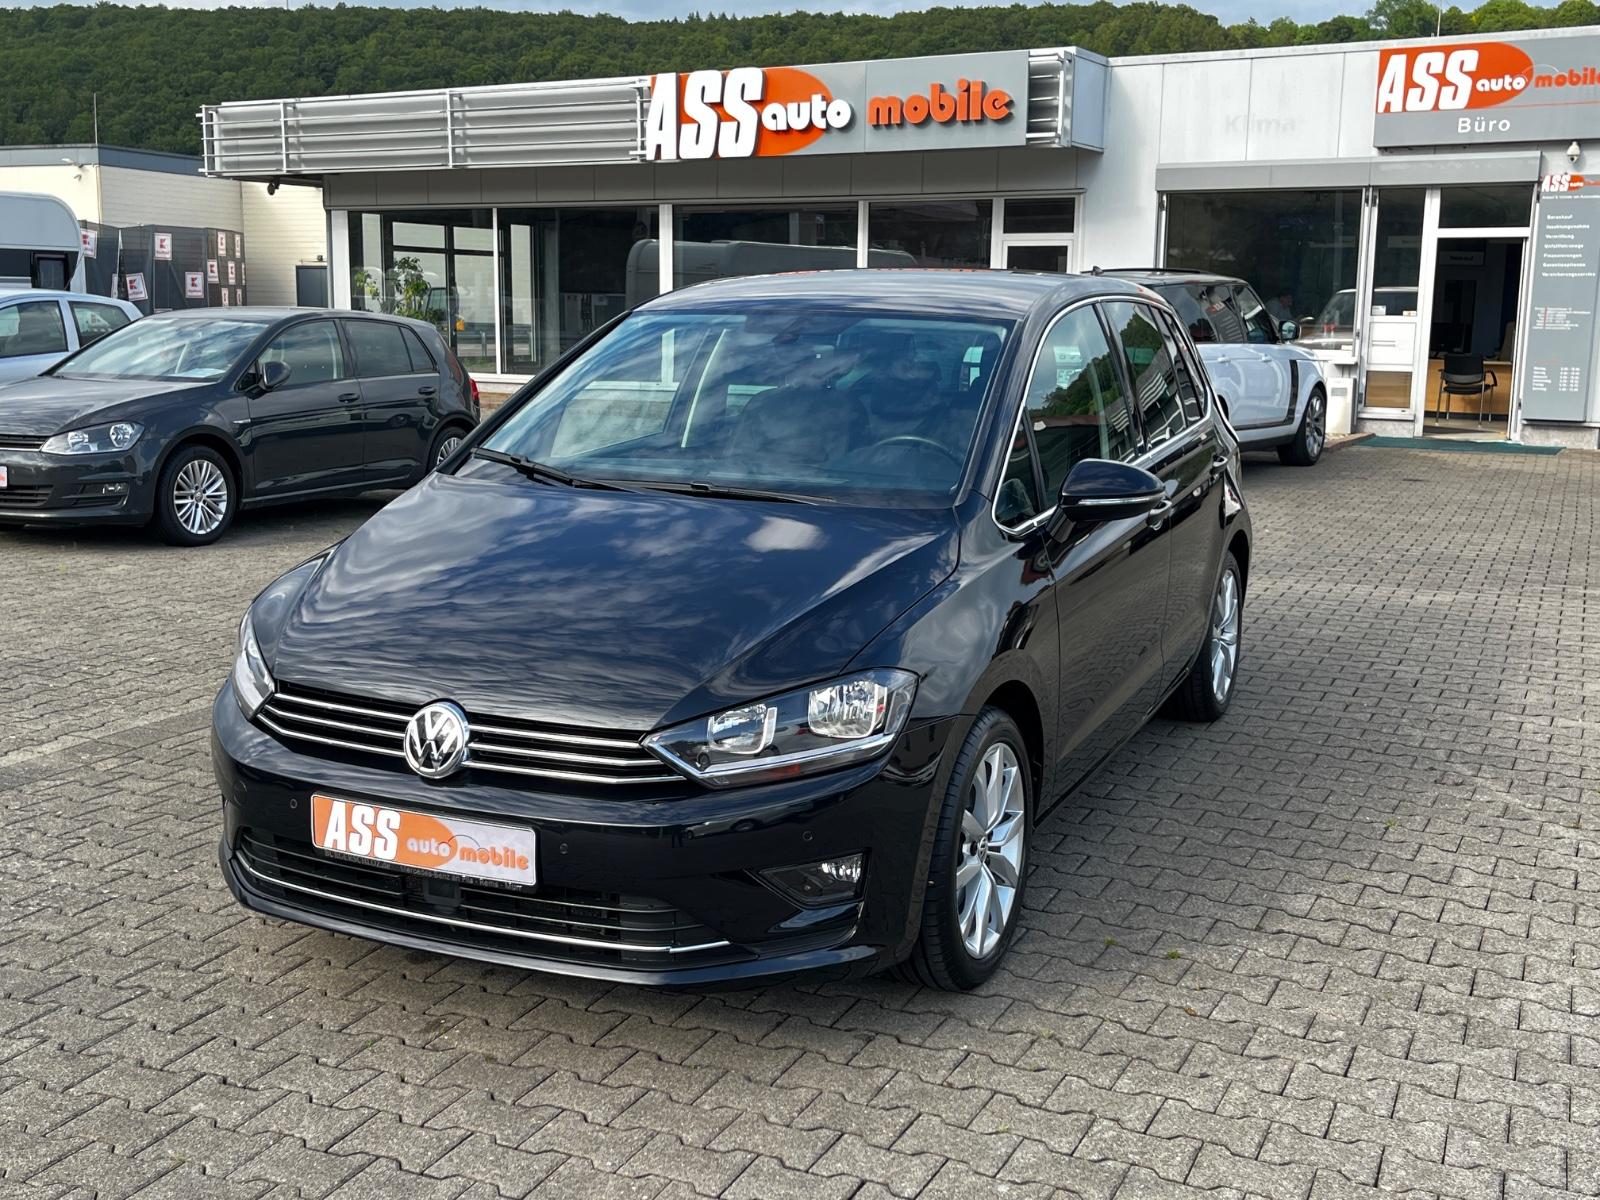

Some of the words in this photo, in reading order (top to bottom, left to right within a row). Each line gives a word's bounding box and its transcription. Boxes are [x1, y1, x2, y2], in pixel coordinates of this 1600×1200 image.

[1377, 49, 1479, 113] ASS
[1475, 74, 1527, 92] auto
[1534, 66, 1600, 88] mobil
[646, 67, 765, 160] ASS
[761, 92, 853, 133] auto
[867, 78, 1014, 128] mobile
[1457, 116, 1511, 134] Büro
[1541, 174, 1571, 193] ASS
[323, 800, 401, 861] ASS
[406, 837, 451, 857] auto
[459, 845, 529, 871] mobile
